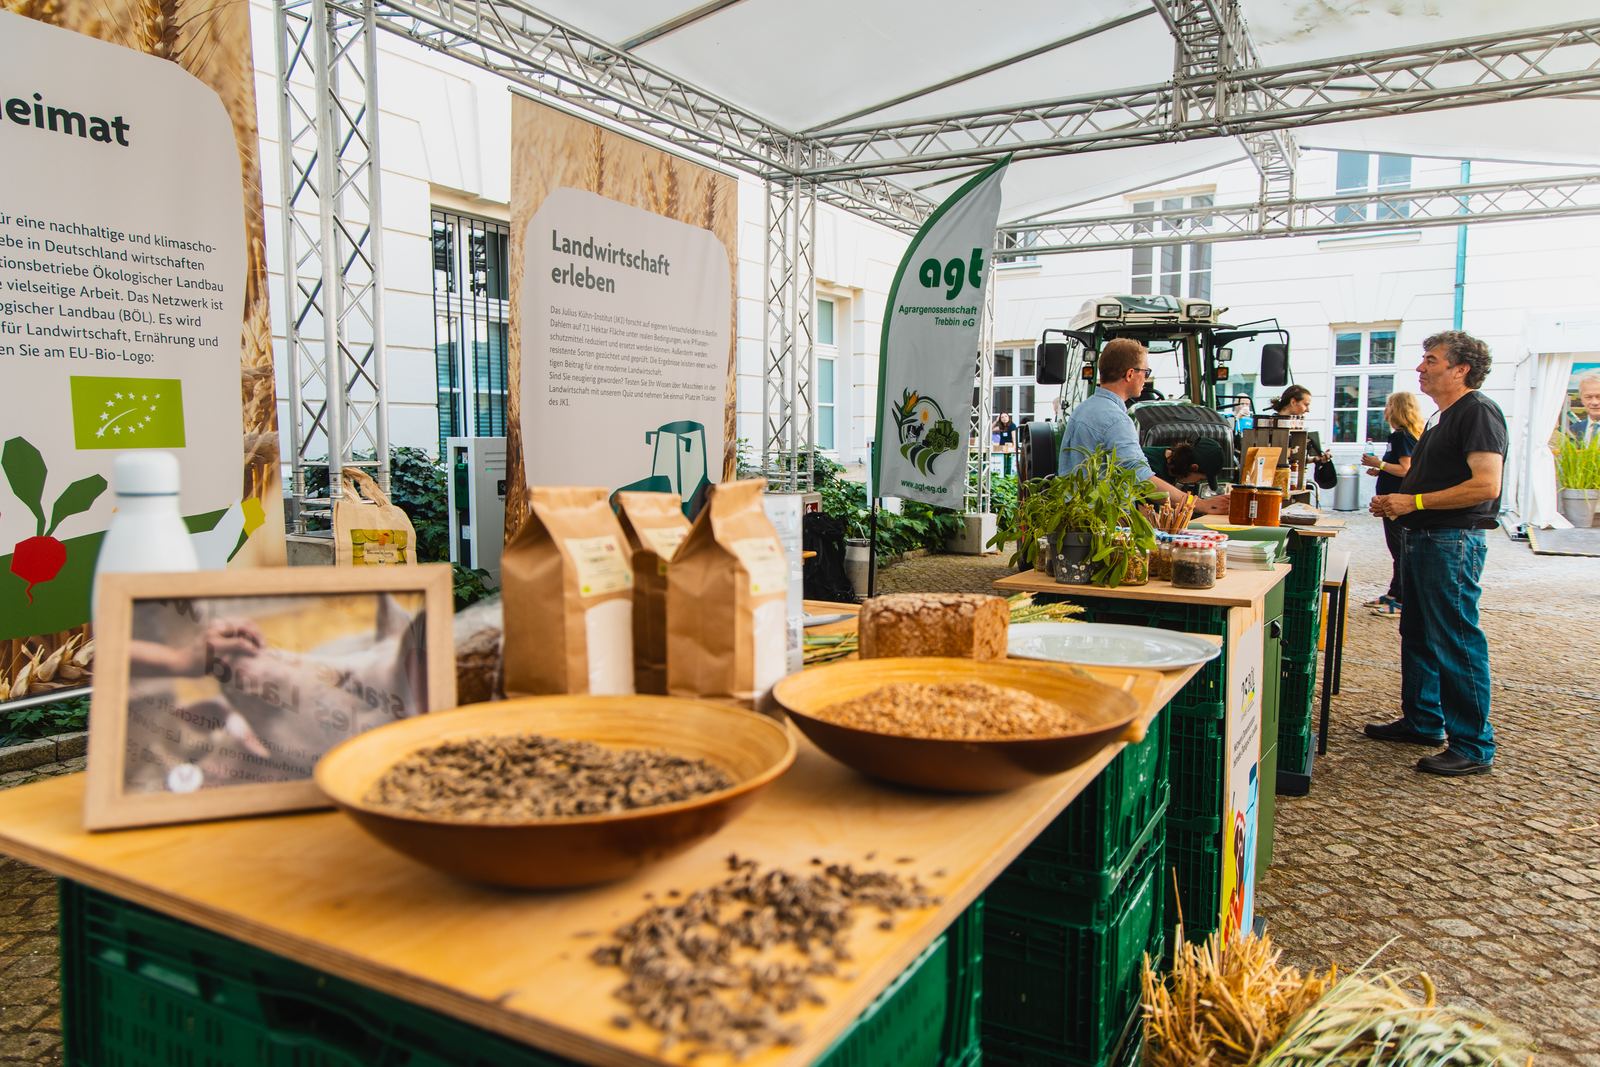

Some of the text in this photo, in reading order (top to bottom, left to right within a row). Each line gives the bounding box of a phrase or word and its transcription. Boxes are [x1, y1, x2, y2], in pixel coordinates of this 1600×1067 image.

[0, 92, 130, 147] eimat
[16, 215, 45, 230] eine
[50, 222, 125, 243] nachhaltige
[128, 233, 150, 245] und
[154, 234, 216, 253] klimascho-
[28, 237, 40, 250] in
[45, 240, 128, 261] Deutschland
[132, 252, 204, 270] wirtschaften
[552, 229, 670, 276] Landwirtschaft
[93, 265, 172, 286] Ökologischer
[176, 276, 224, 292] Landbau
[552, 263, 615, 293] erleben
[919, 248, 984, 300] agt
[7, 279, 76, 298] vielseitige
[80, 286, 124, 301] Arbeit.
[128, 290, 148, 304] Das
[152, 293, 208, 309] Netzwerk
[212, 300, 224, 310] ist
[59, 304, 114, 320] Landbau
[119, 308, 156, 324] (BÖL).
[159, 313, 172, 326] Es
[176, 314, 202, 327] wird
[550, 305, 560, 314] Das
[562, 307, 578, 317] Julius
[899, 305, 977, 315] Agrargenossenschaft
[550, 318, 572, 329] Dahlem
[572, 322, 582, 330] auf
[591, 324, 608, 334] Hektar
[610, 327, 625, 336] Fläche
[935, 317, 975, 327] Trebbin eG
[2, 321, 218, 348] für Landwirtschaft, Ernährung und
[550, 332, 584, 344] schutzmittel
[584, 338, 608, 346] reduziert
[619, 340, 635, 349] ersetzt
[636, 344, 652, 352] werden
[20, 344, 40, 356] Sie
[44, 348, 64, 358] am
[70, 347, 154, 364] EU-Bio-Logo:
[550, 347, 576, 355] resistente
[577, 348, 594, 357] Sorten
[596, 351, 620, 360] gezüchtet
[550, 359, 563, 368] tigen
[565, 360, 584, 370] Beitrag
[549, 371, 561, 380] Sind
[562, 372, 571, 380] Sie
[572, 374, 596, 384] neugierig
[549, 385, 589, 394] Landwirtschaft
[622, 390, 634, 398] Quiz
[901, 480, 948, 494] www.agt-eg.de
